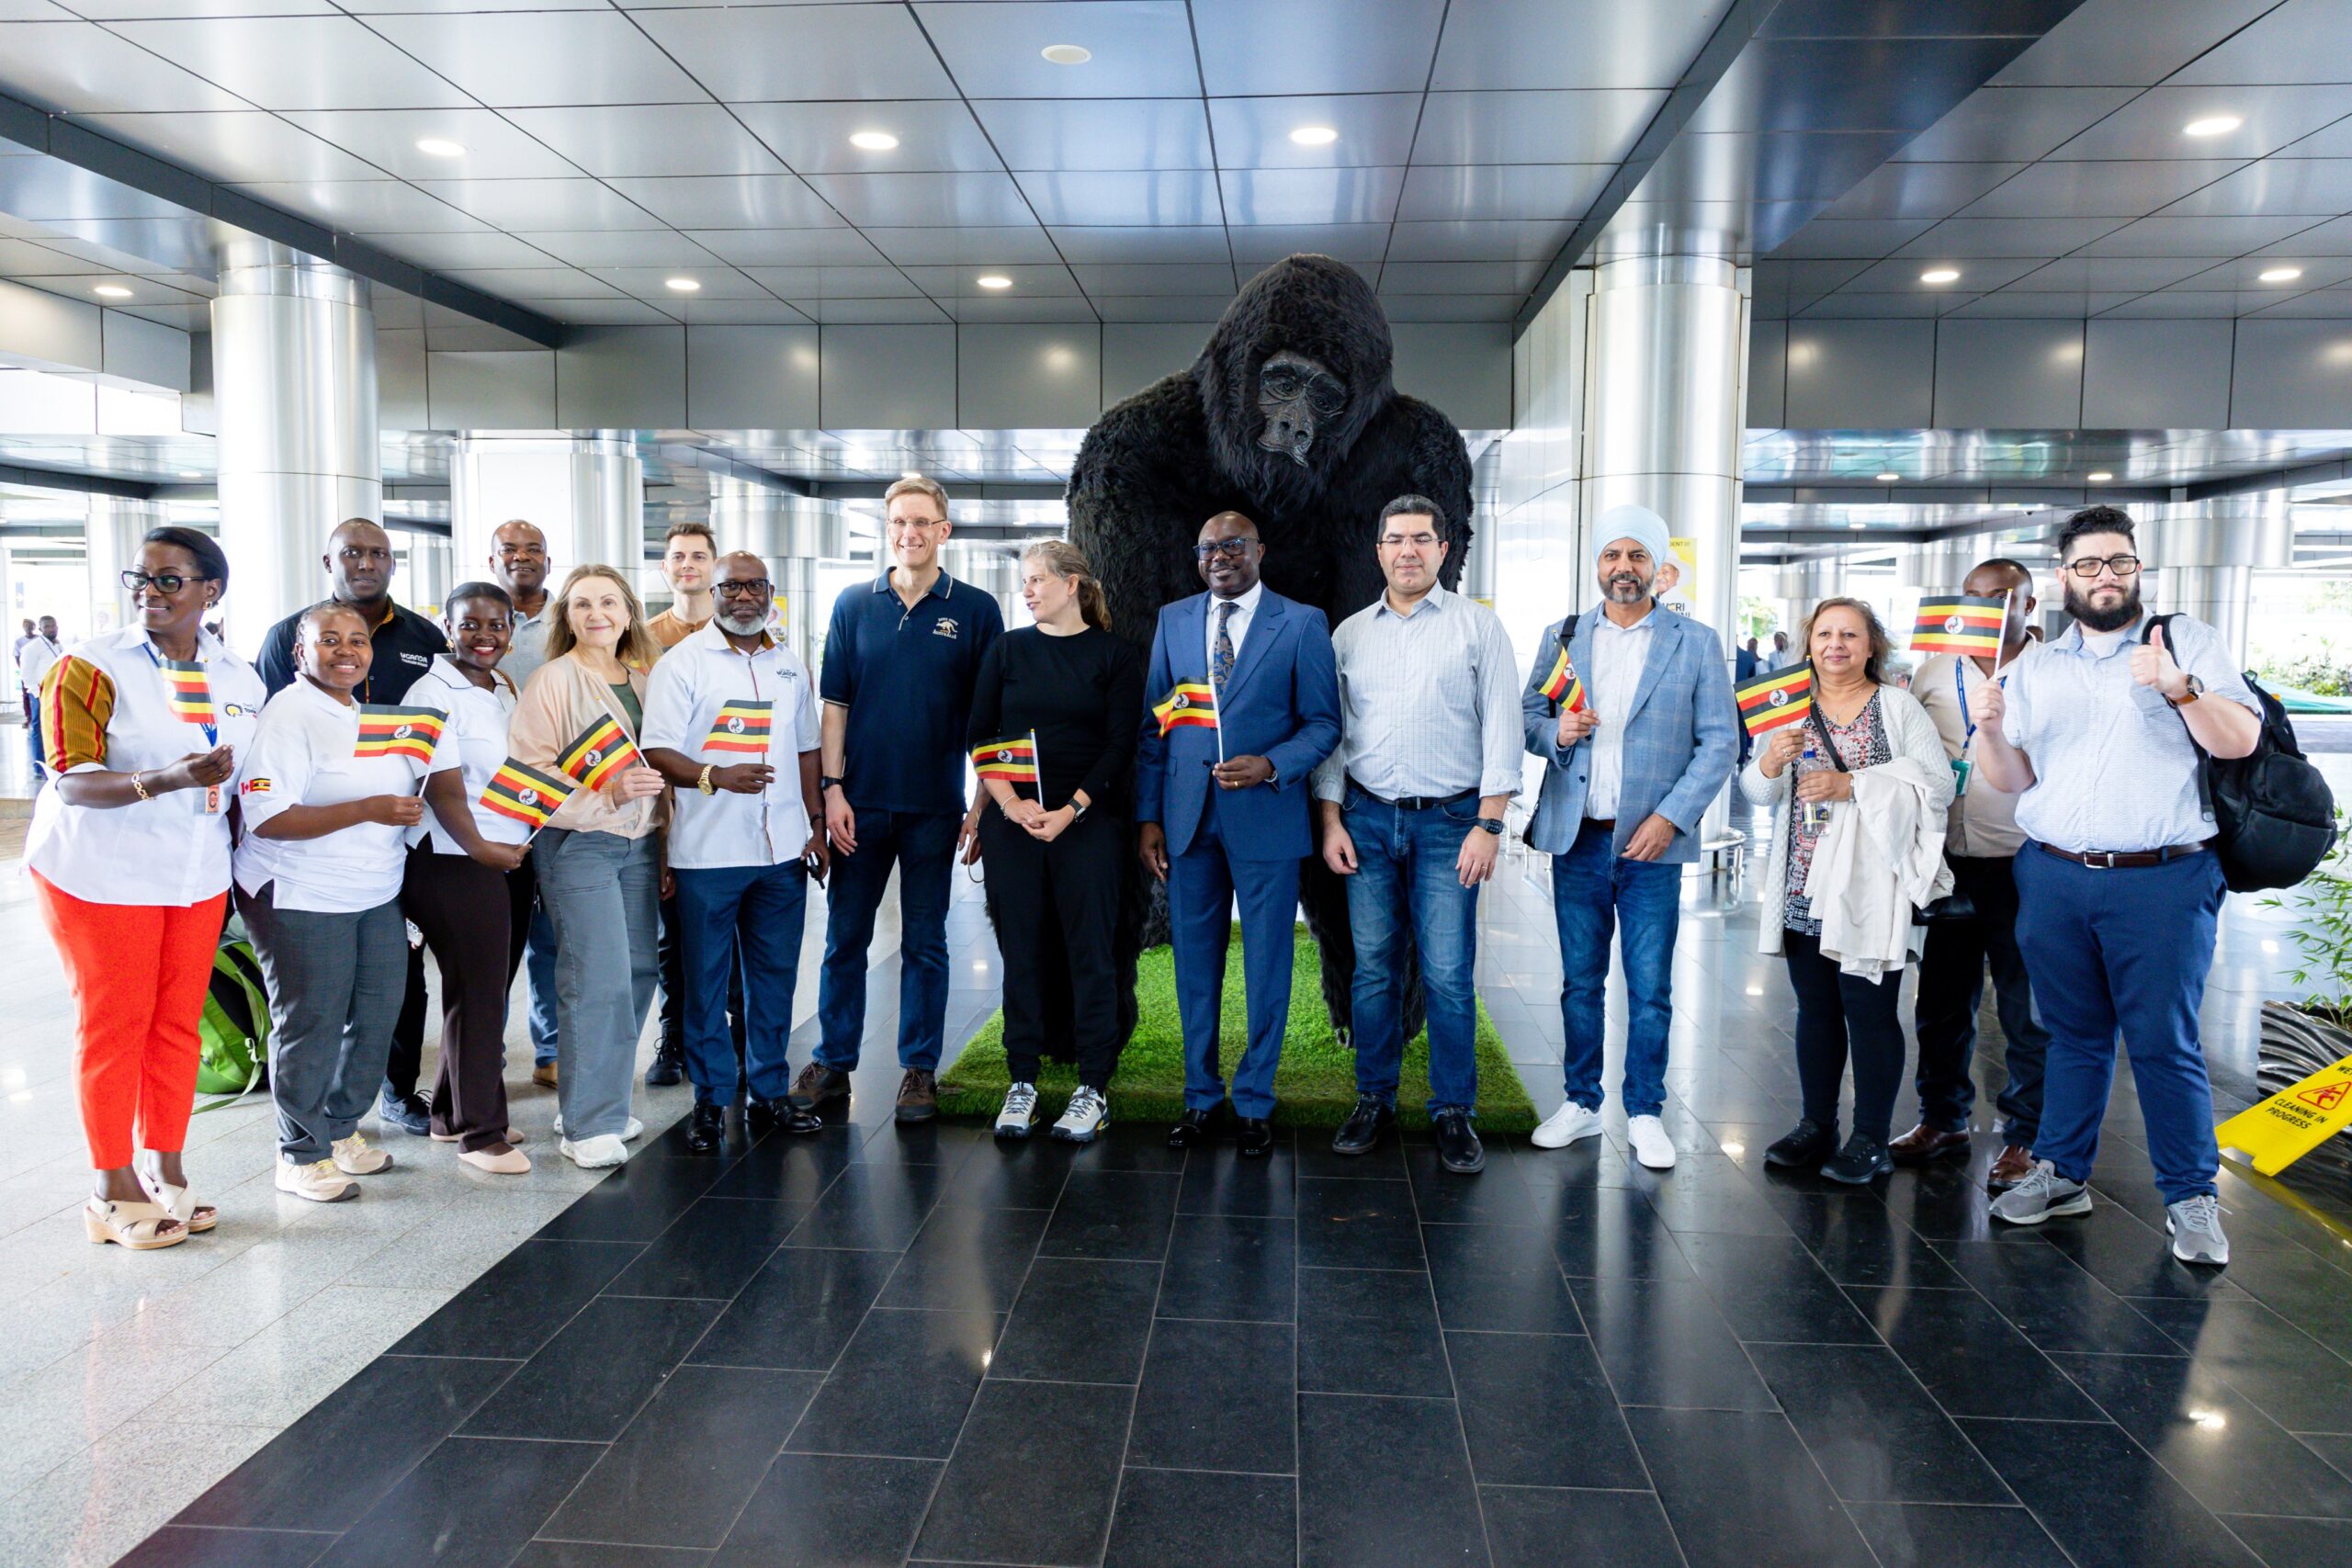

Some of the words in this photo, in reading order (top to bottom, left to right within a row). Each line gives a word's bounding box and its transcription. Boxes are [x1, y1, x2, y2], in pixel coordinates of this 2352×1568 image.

[2266, 1107, 2312, 1129] PROGRESS
[2274, 1099, 2317, 1119] CLEANING
[2314, 1115, 2328, 1123] IN
